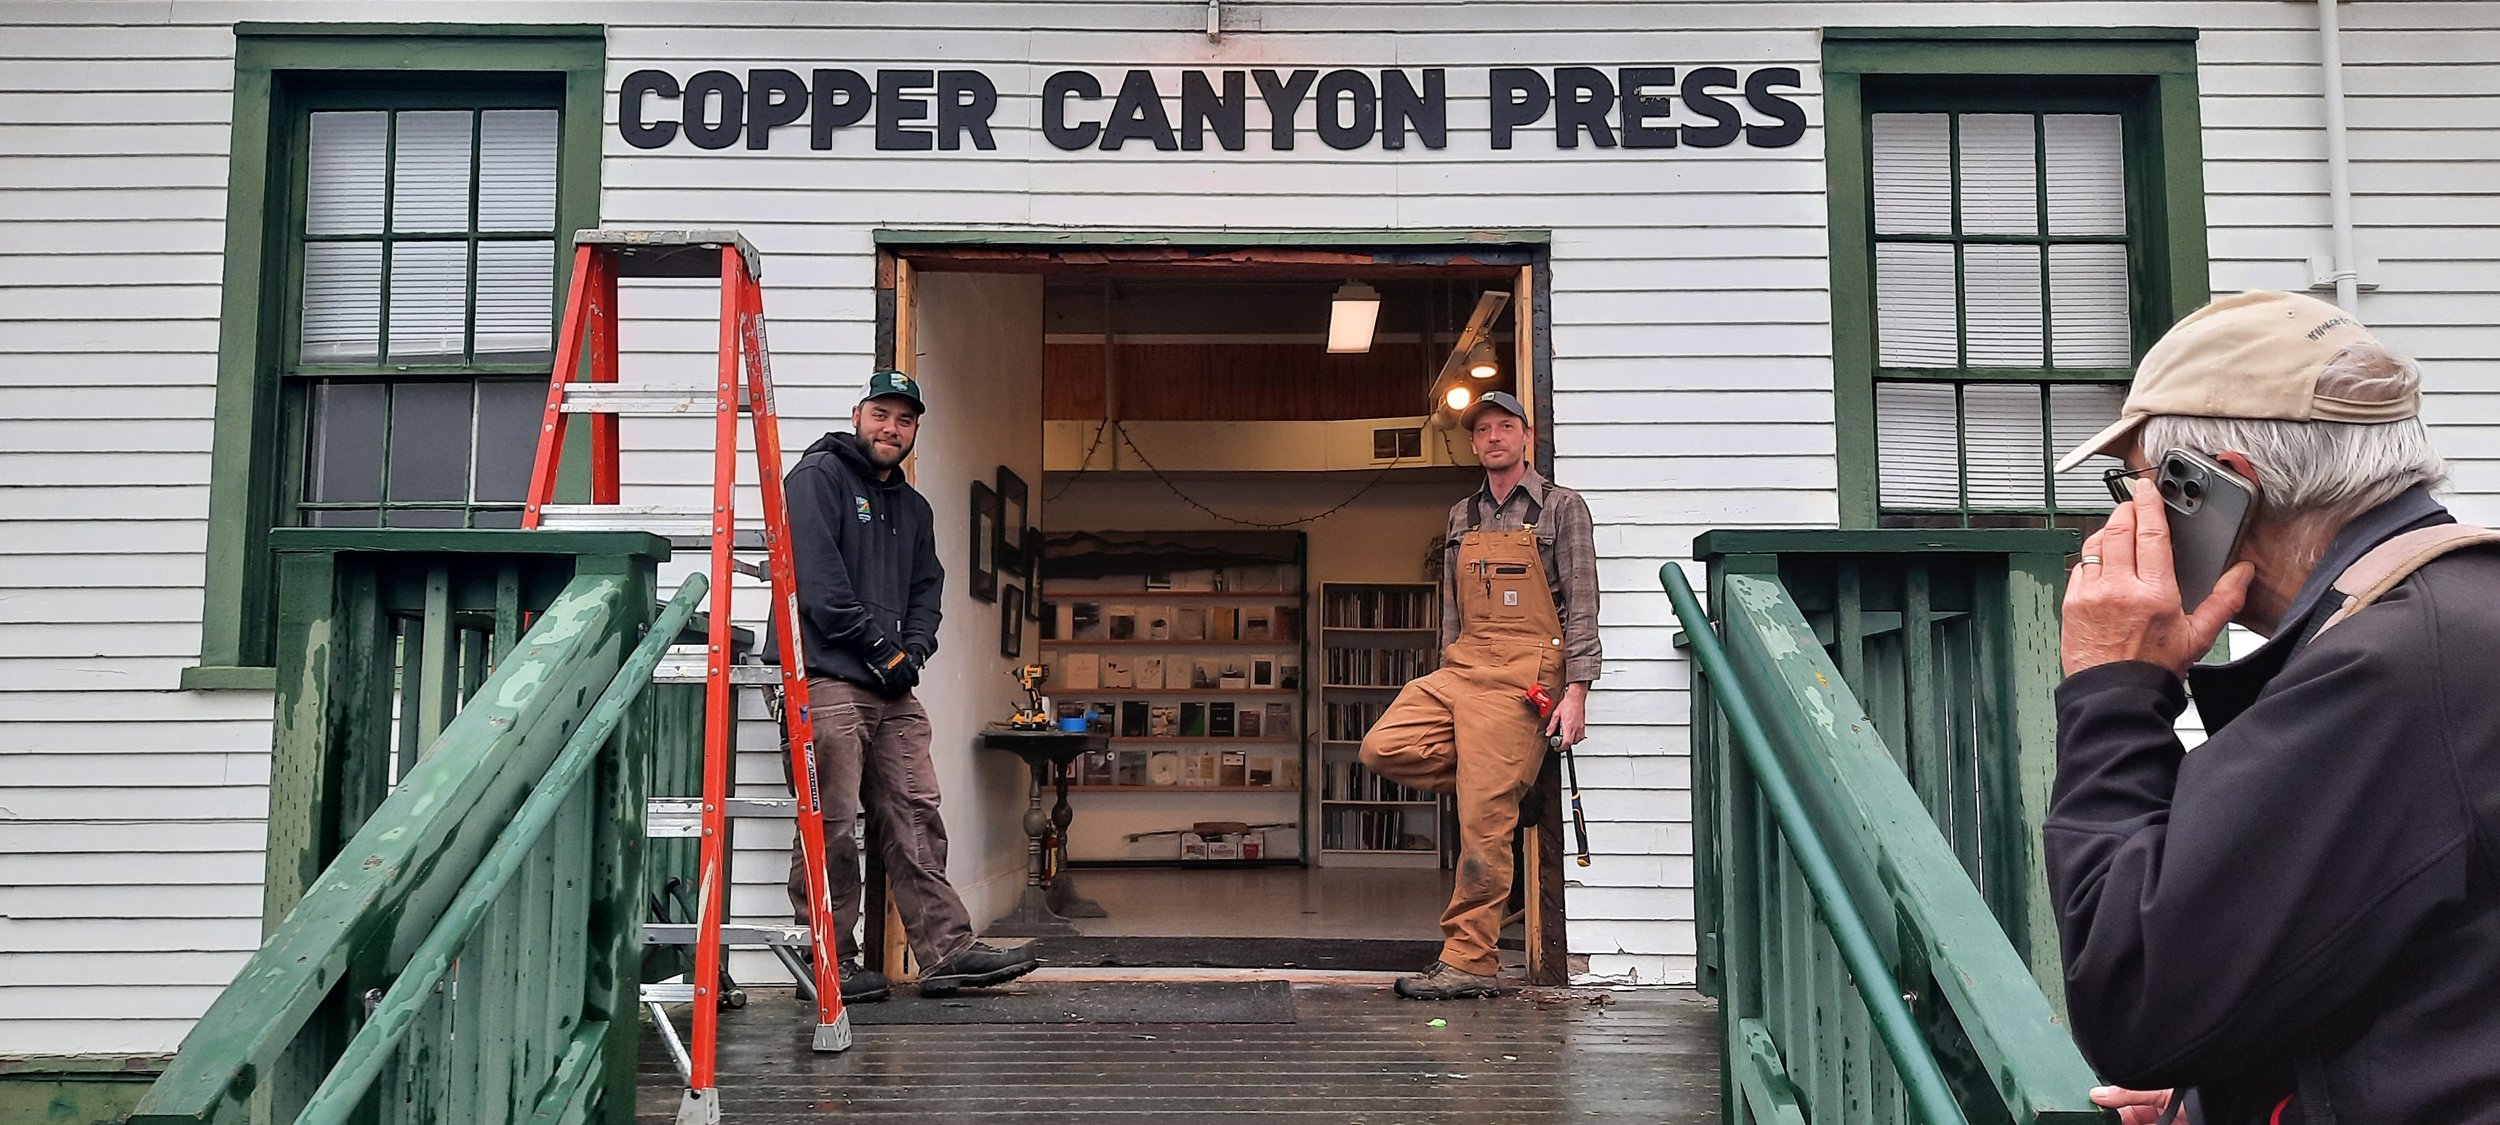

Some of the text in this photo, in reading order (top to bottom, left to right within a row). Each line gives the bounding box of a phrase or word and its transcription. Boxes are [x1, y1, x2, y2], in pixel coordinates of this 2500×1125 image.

[618, 67, 1807, 151] COPPER CANYON PRESS
